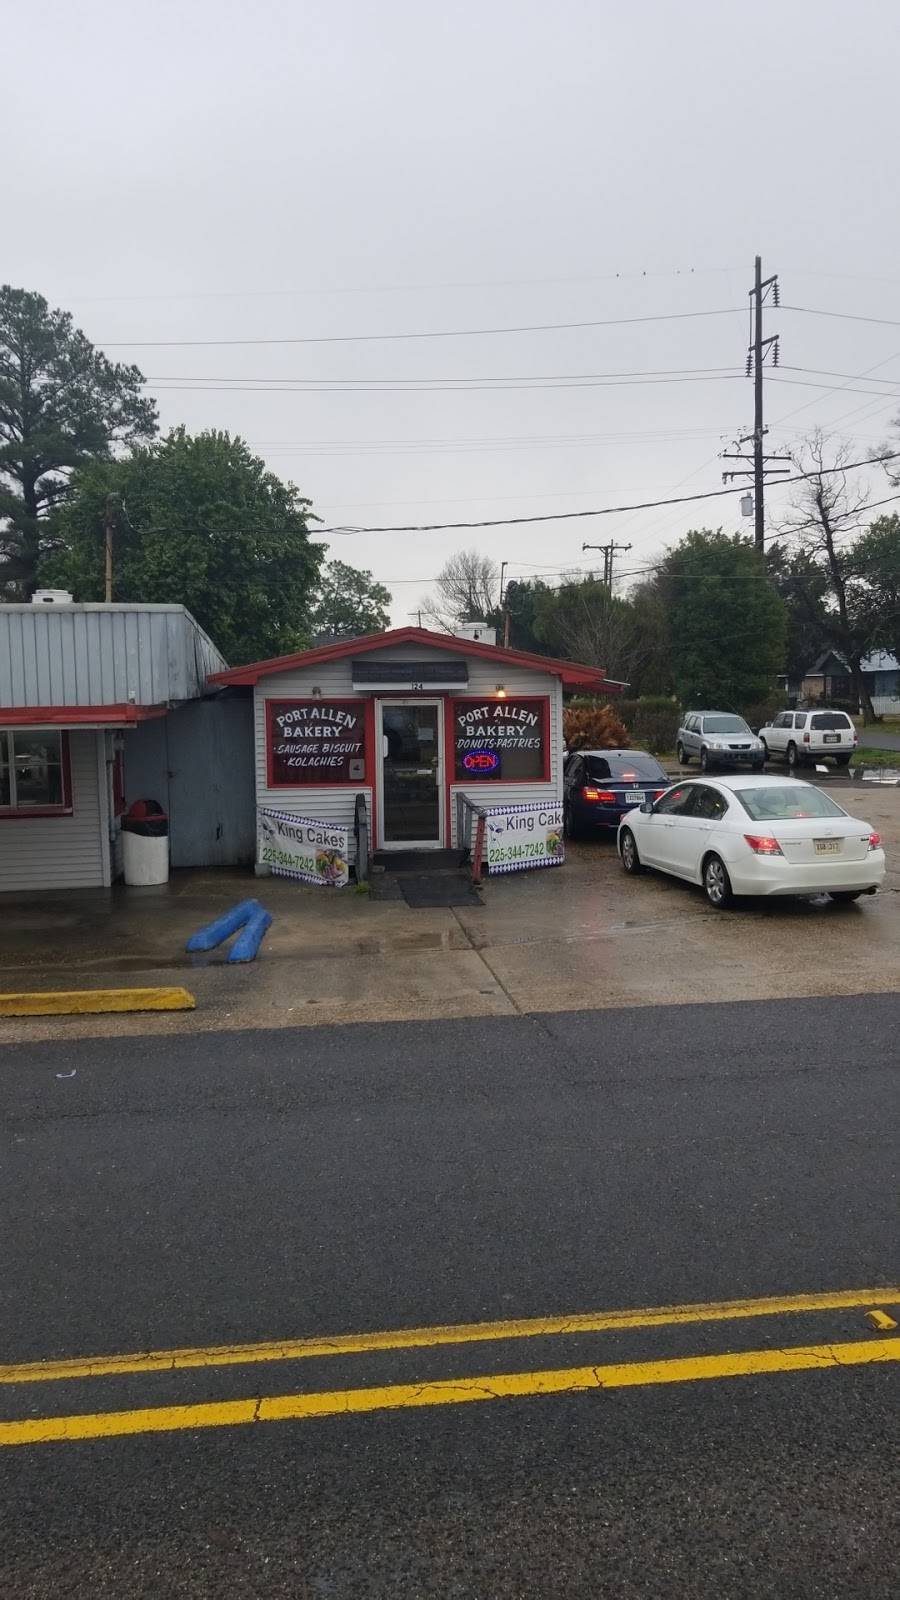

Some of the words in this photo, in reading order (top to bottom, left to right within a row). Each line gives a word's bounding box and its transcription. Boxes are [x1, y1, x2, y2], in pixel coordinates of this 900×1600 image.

[277, 708, 308, 727] PORT
[311, 707, 357, 729] ALLEN
[458, 706, 489, 727] PORT
[493, 705, 538, 726] ALLEN
[283, 726, 342, 737] BAKERY
[466, 725, 527, 736] BAKERY
[277, 743, 319, 754] SAUSAGE
[322, 743, 362, 753] BISCUIT
[464, 755, 496, 768] OPEN
[506, 815, 534, 831] King
[277, 821, 303, 843] King
[307, 828, 345, 848] Cakes
[262, 847, 315, 872] 225-344-7242
[489, 842, 544, 863] 225-344-7242
